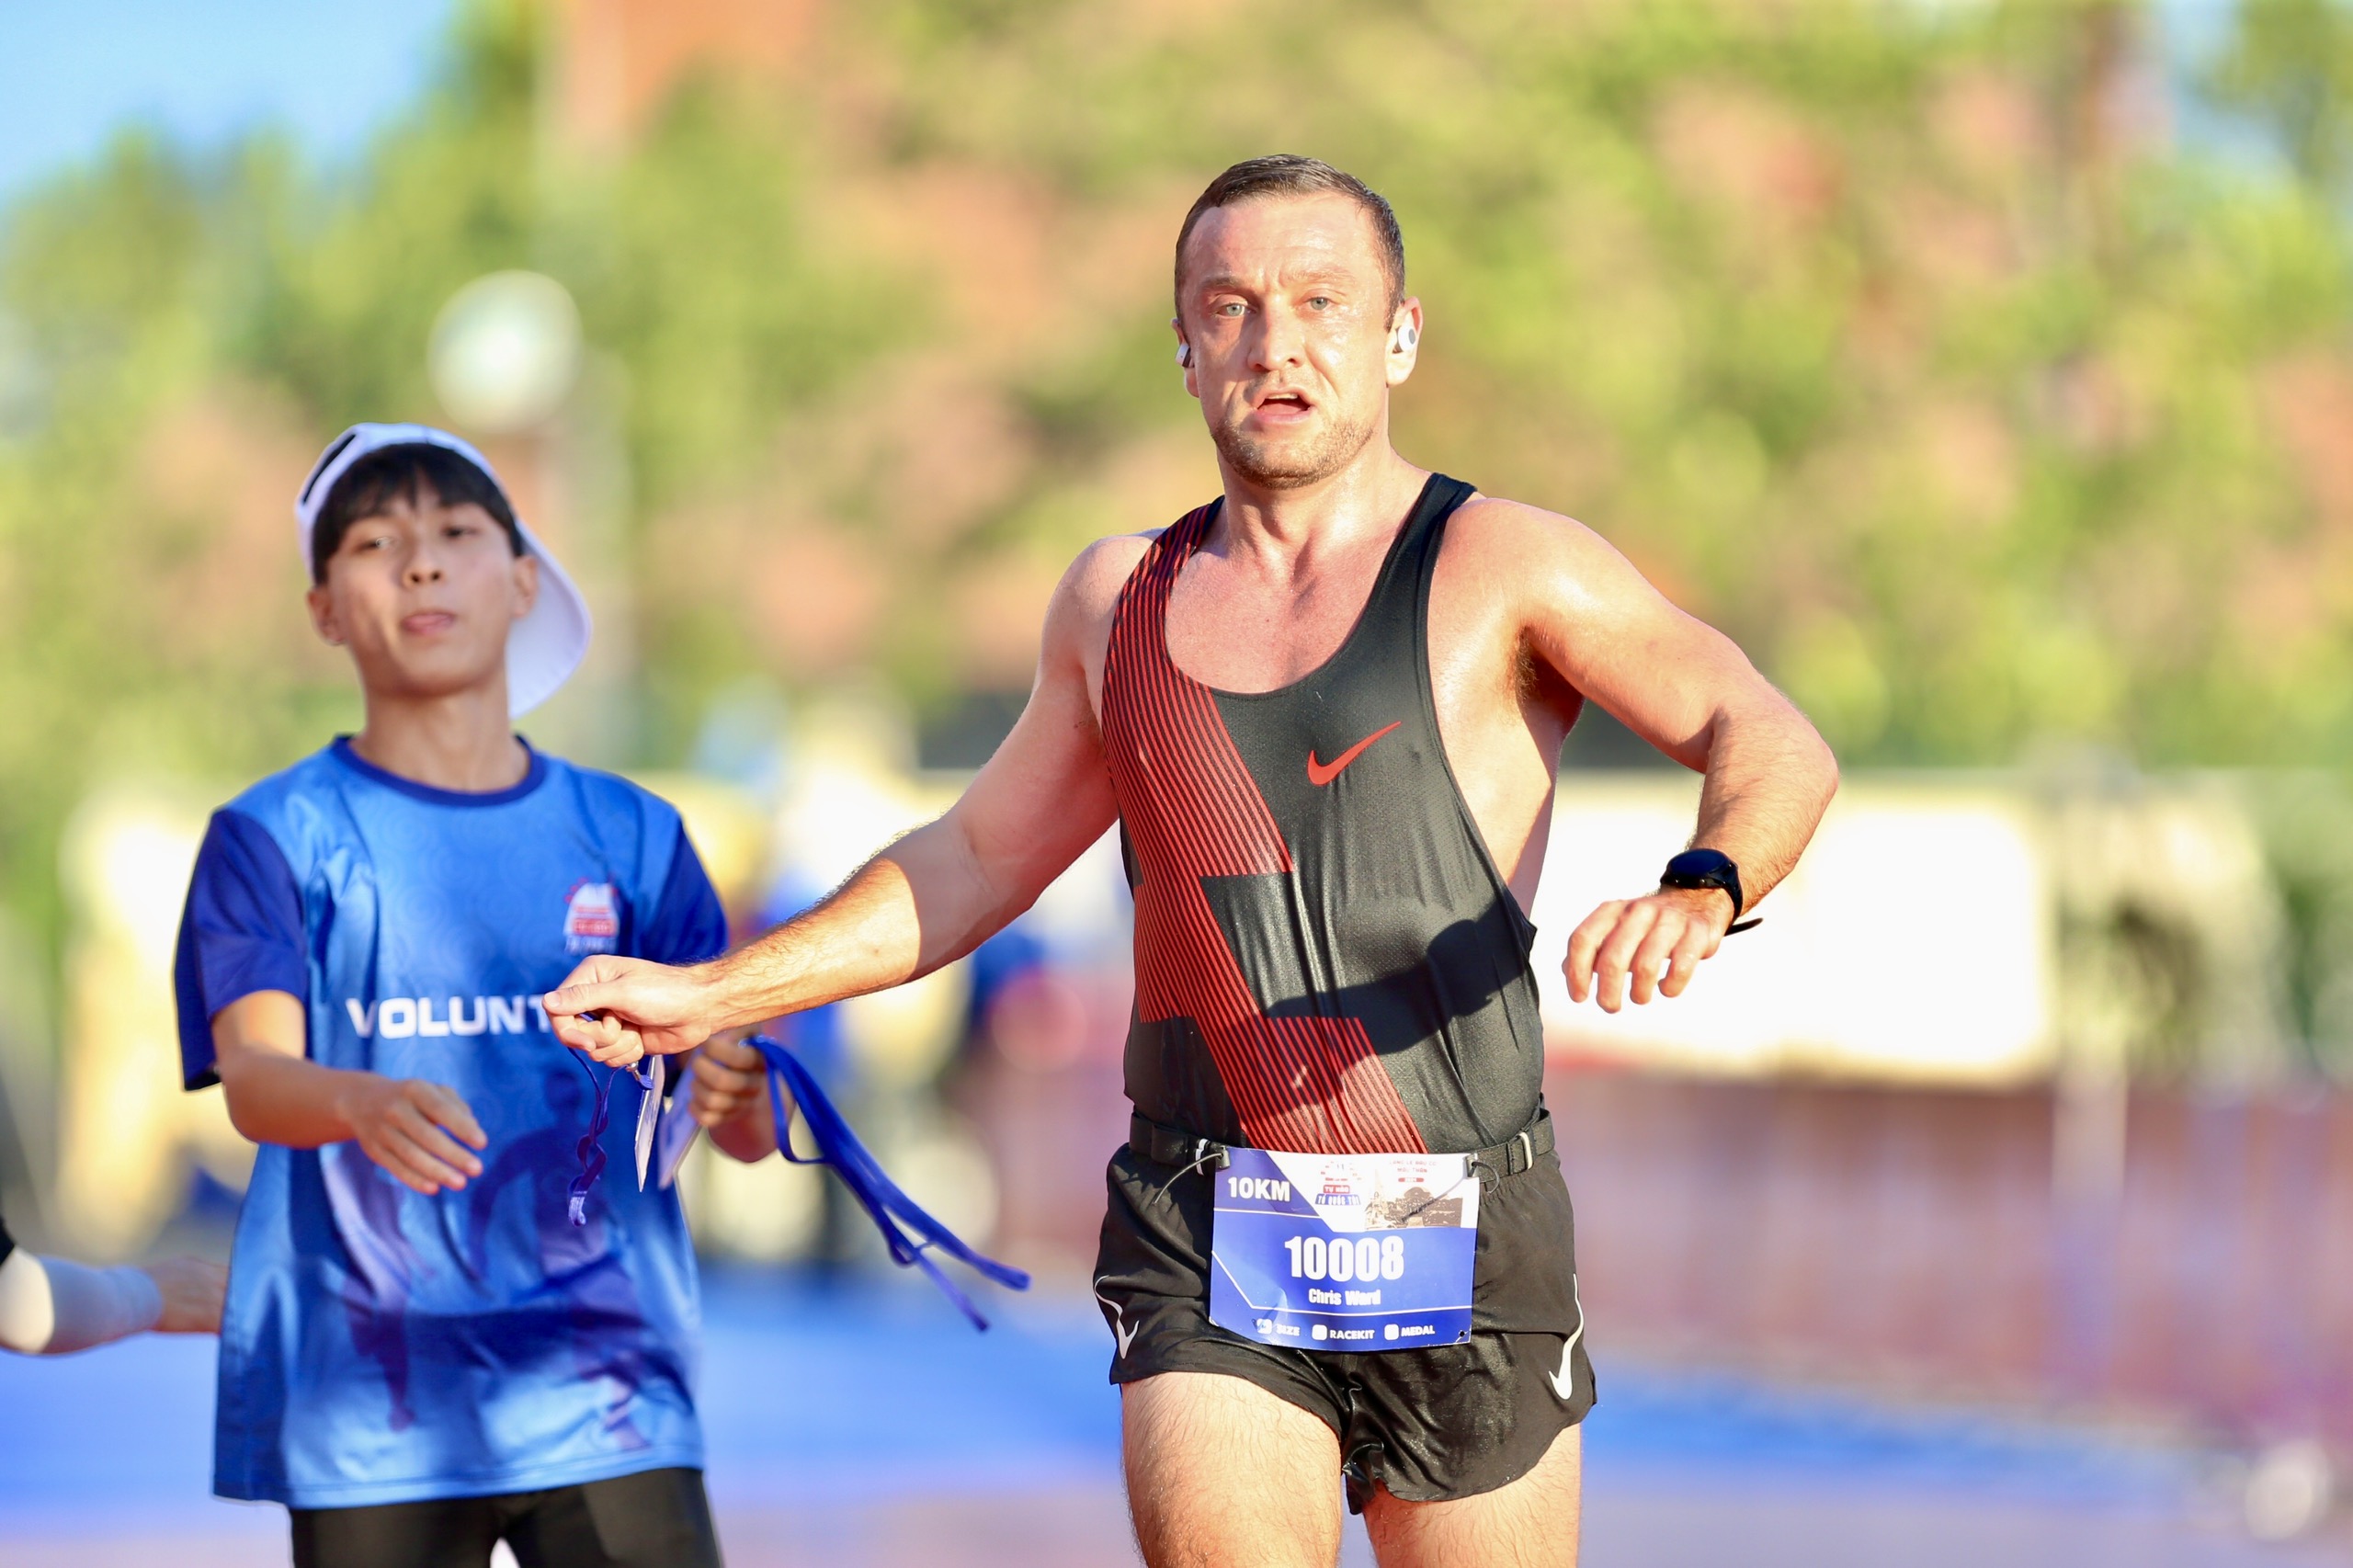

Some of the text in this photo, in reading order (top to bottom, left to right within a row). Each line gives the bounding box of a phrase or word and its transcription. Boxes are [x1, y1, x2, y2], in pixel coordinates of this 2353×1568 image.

[1227, 1176, 1290, 1202] 10KM
[1284, 1235, 1404, 1282] 10008
[1309, 1288, 1381, 1306] Chris Ward
[1329, 1330, 1375, 1340] RACEKIT
[1401, 1324, 1436, 1337] MEDAL
